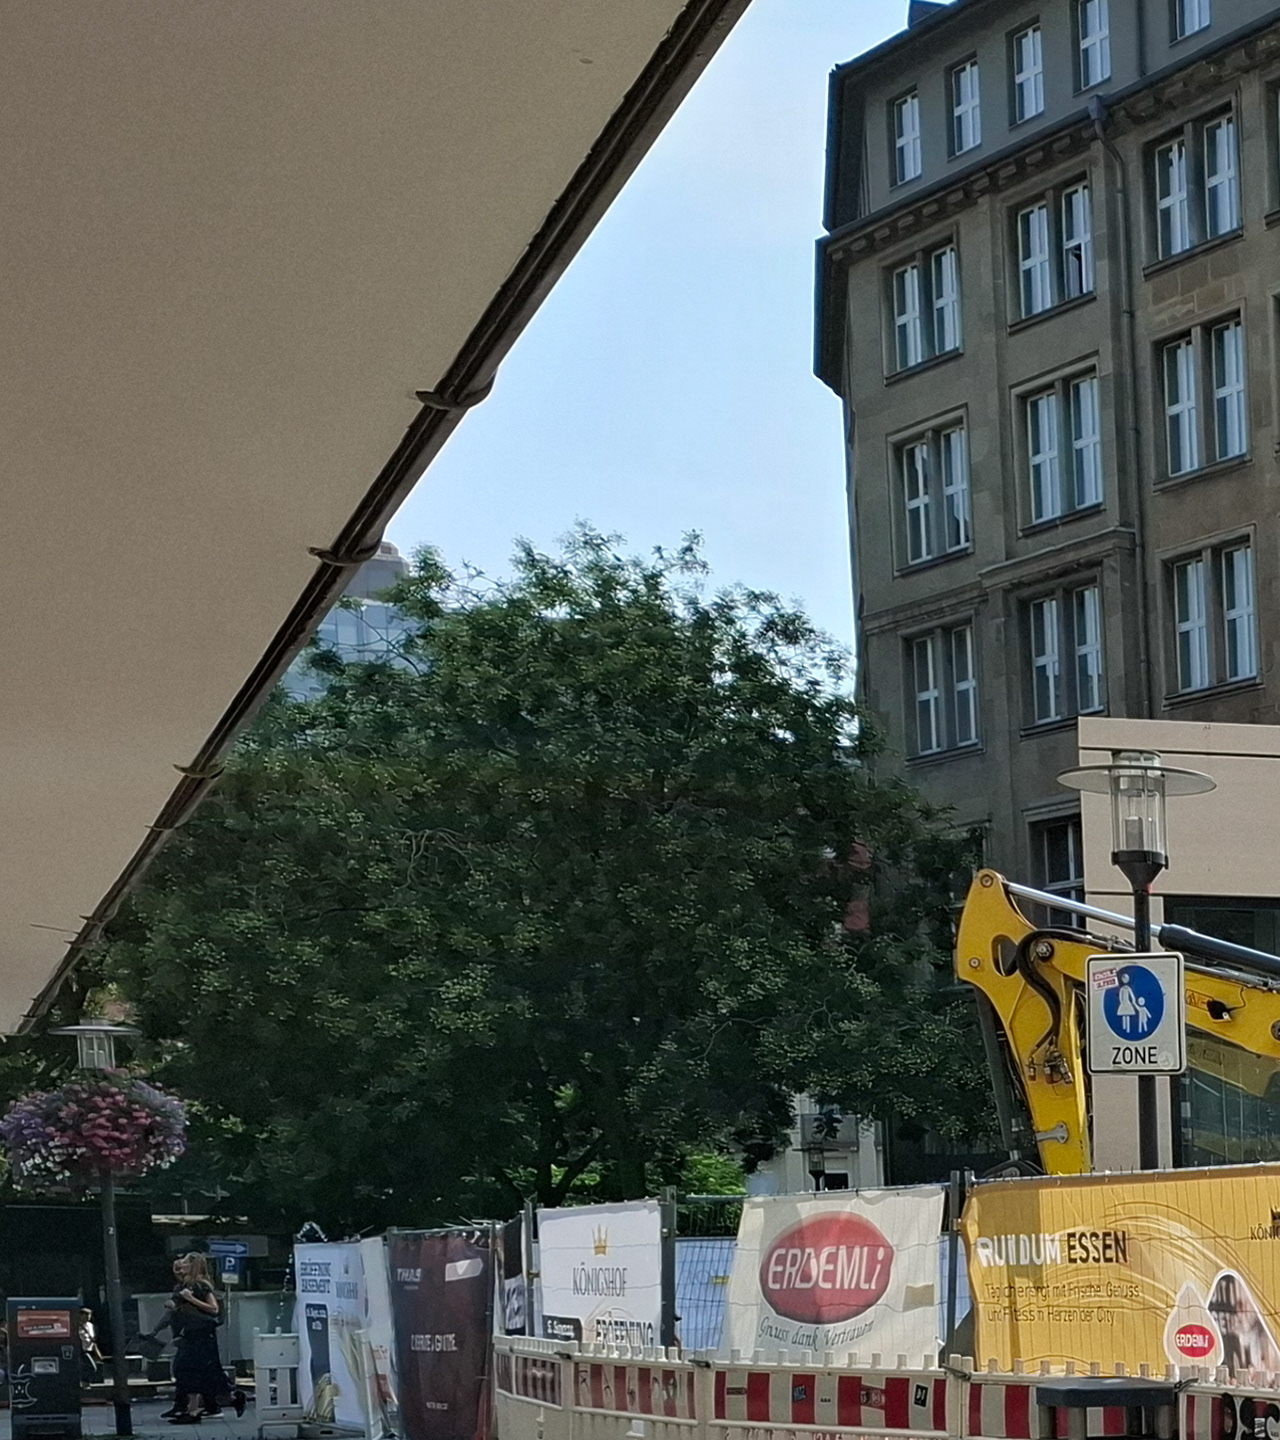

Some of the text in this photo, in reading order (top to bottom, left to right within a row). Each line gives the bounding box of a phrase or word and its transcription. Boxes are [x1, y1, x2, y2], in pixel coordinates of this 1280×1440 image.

[1112, 1046, 1158, 1065] ZONE
[1067, 1230, 1128, 1264] ESSEN
[791, 1325, 820, 1352] dank
